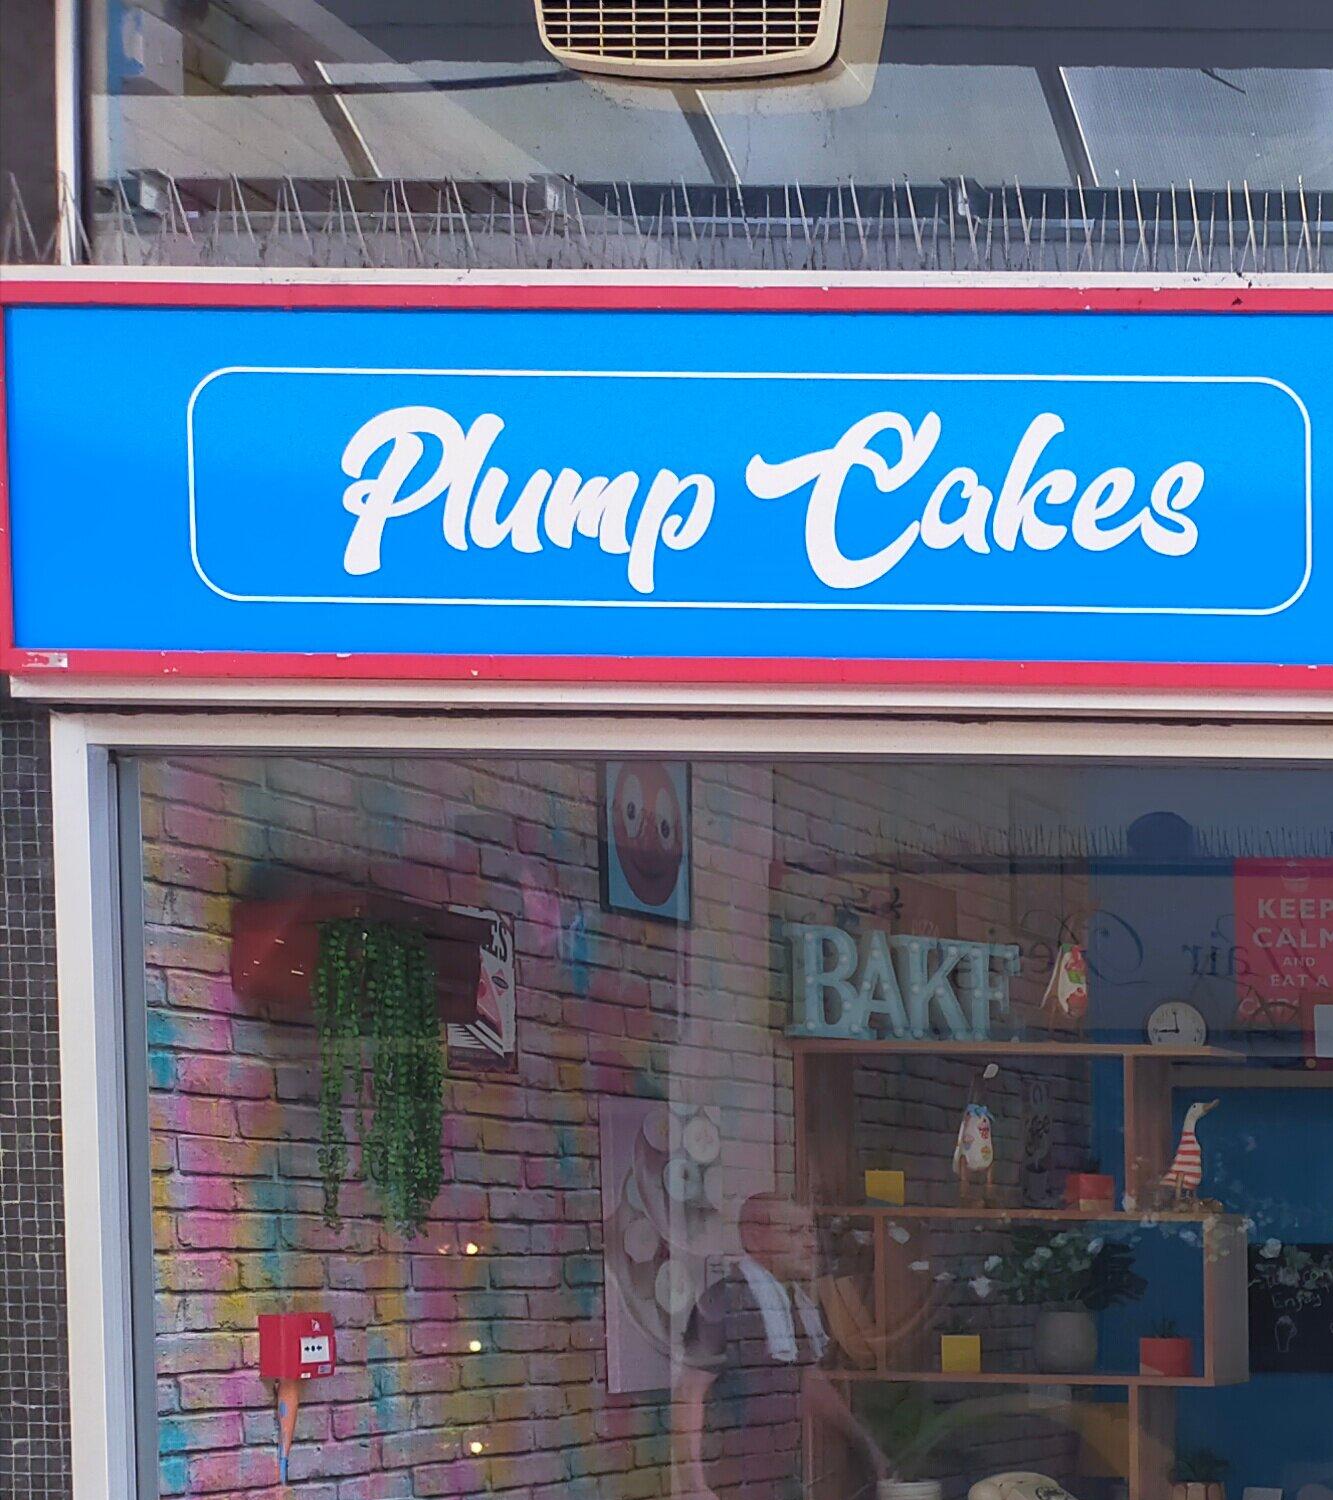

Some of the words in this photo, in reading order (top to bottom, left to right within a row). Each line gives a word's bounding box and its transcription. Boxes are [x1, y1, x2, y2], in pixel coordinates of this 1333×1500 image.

[341, 406, 714, 594] Plump
[746, 412, 1204, 588] Cakes
[1283, 956, 1315, 967] AND
[1270, 974, 1308, 987] EAT
